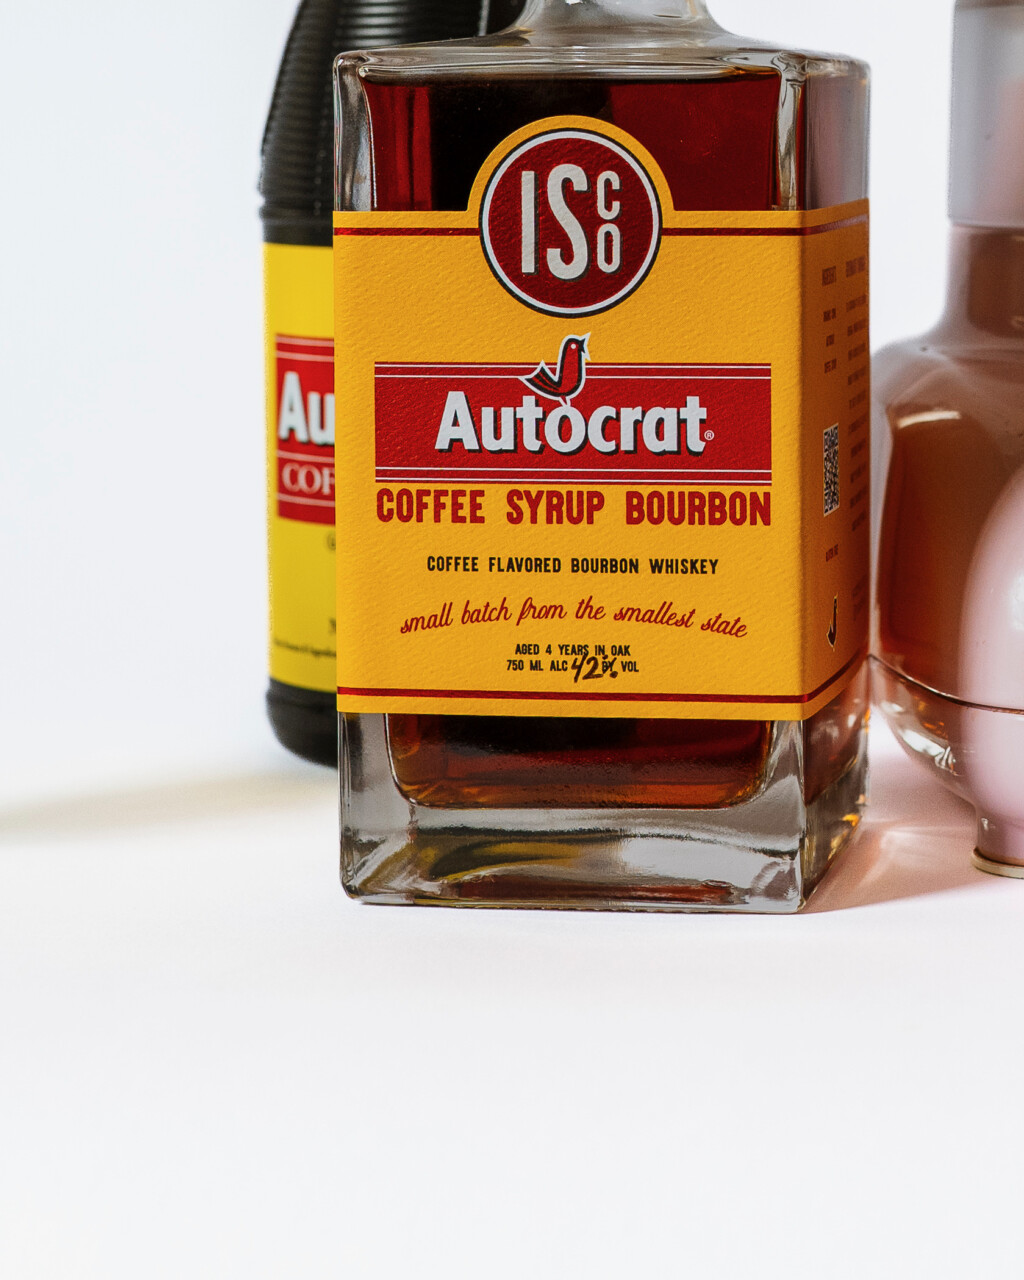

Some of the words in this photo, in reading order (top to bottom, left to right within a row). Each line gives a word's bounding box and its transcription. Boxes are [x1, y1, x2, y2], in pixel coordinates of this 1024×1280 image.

[376, 488, 486, 524] COFFEE
[506, 489, 605, 525] SYRUP
[625, 491, 772, 526] BOURBON
[427, 555, 479, 572] COFFEE
[488, 556, 561, 573] FLAVORED
[570, 557, 639, 574] BOURBON
[649, 558, 719, 575] WHISKEY
[400, 601, 454, 634] small
[461, 596, 513, 625] batch
[516, 596, 568, 626] from
[575, 595, 606, 620] the
[613, 601, 696, 628] smallest
[700, 613, 748, 638] state
[515, 644, 540, 655] AGED
[545, 644, 552, 655] 4
[558, 644, 589, 656] YEARS
[594, 645, 605, 656] IN
[611, 645, 631, 656] OAK
[506, 660, 524, 671] 750
[530, 660, 544, 671] ML
[550, 660, 568, 671] ALC
[621, 661, 639, 672] VOL
